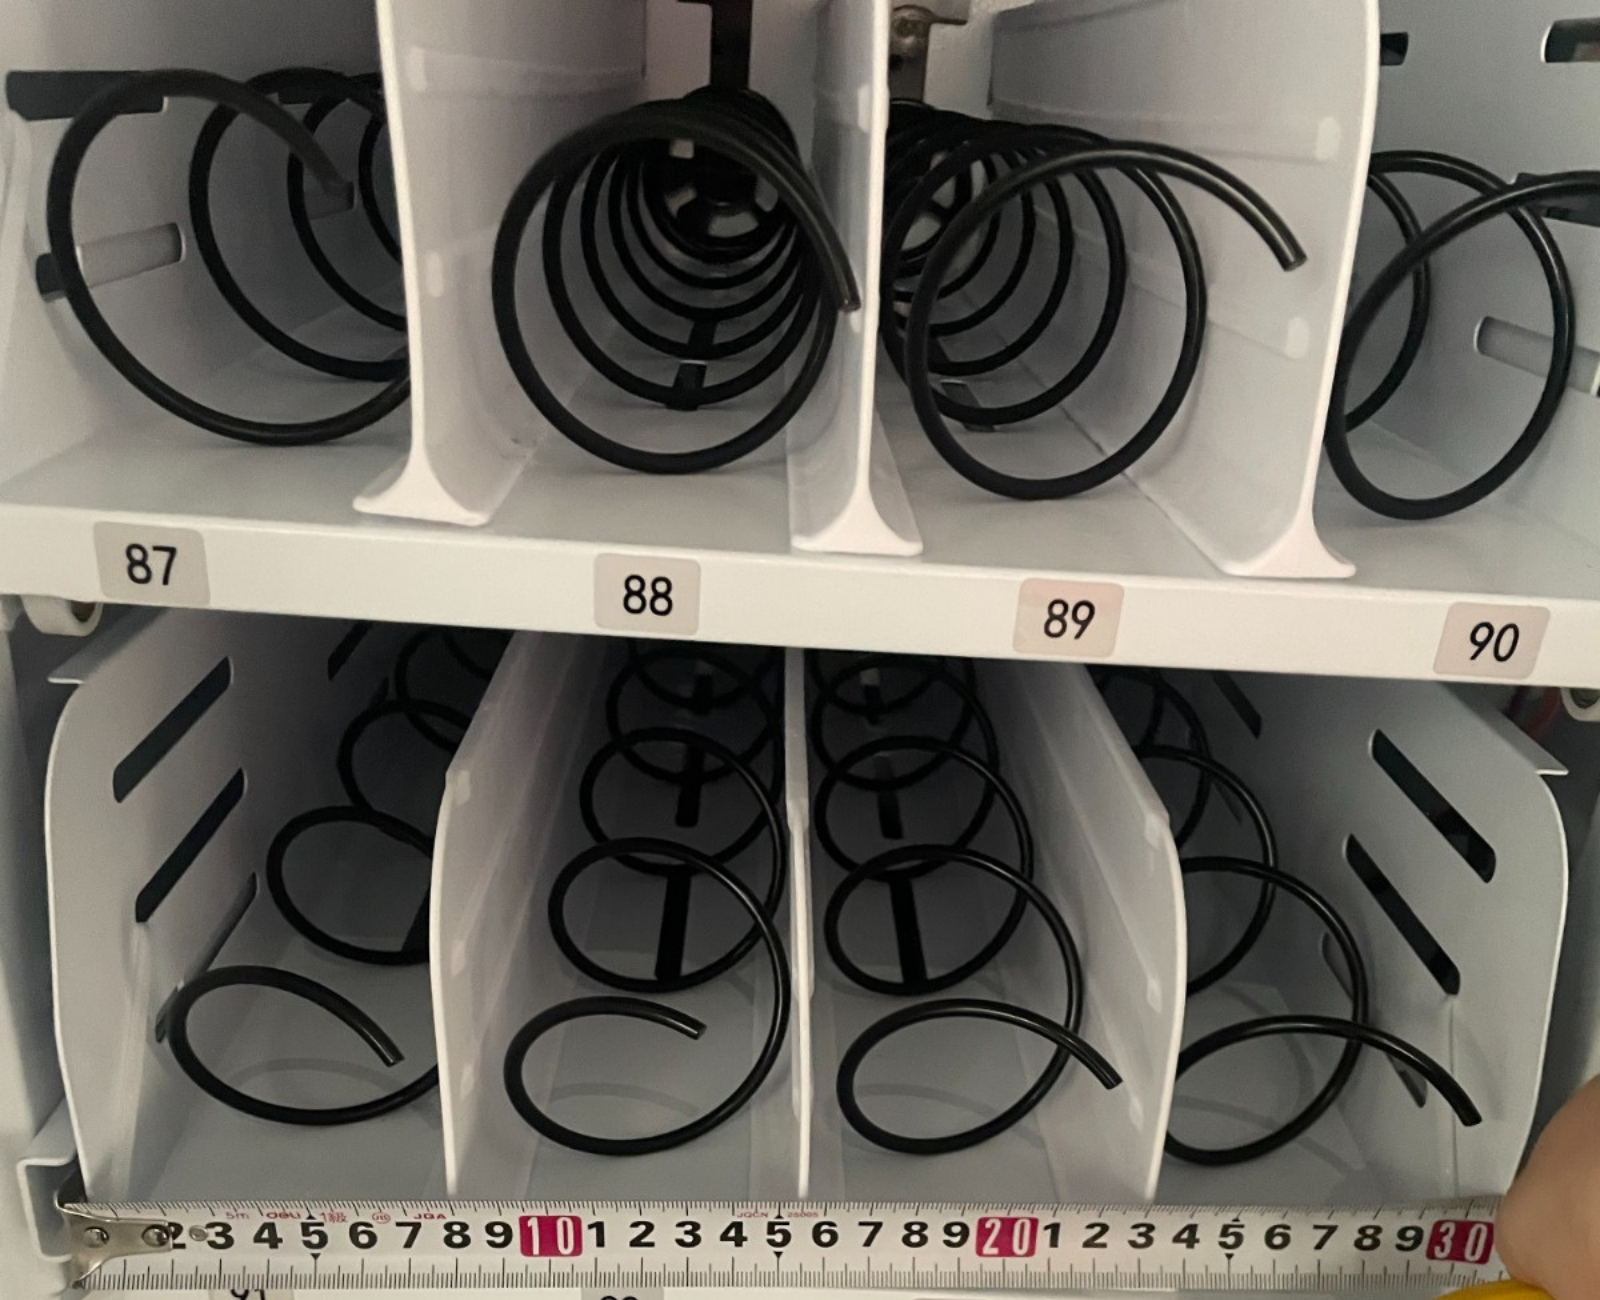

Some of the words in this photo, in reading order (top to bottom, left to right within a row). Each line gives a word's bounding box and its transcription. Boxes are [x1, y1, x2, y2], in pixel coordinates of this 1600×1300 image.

[125, 543, 177, 586] 87
[623, 574, 673, 617] 88
[1044, 599, 1095, 640] 89
[1469, 621, 1520, 663] 90
[205, 1221, 235, 1250] 3
[253, 1221, 284, 1250] 4
[300, 1221, 329, 1250] 5
[348, 1221, 378, 1250] 6
[395, 1221, 422, 1249] 7
[443, 1221, 472, 1249] 8
[484, 1221, 513, 1249] 9
[527, 1216, 575, 1256] 10
[587, 1221, 605, 1248] 1
[629, 1220, 655, 1248] 2
[675, 1220, 702, 1248] 3
[719, 1221, 748, 1248] 4
[766, 1221, 792, 1248] 5
[811, 1220, 839, 1248] 6
[858, 1221, 884, 1248] 7
[901, 1221, 929, 1248] 8
[942, 1221, 970, 1249] 9
[983, 1218, 1031, 1255] 20
[1043, 1222, 1061, 1248] 1
[1082, 1222, 1110, 1249] 2
[1127, 1222, 1156, 1249] 3
[1172, 1223, 1200, 1249] 4
[1218, 1223, 1245, 1250] 5
[1264, 1223, 1292, 1250] 6
[1312, 1224, 1339, 1251] 7
[1353, 1224, 1384, 1251] 8
[1394, 1225, 1425, 1251] 9
[1433, 1221, 1489, 1262] 30
